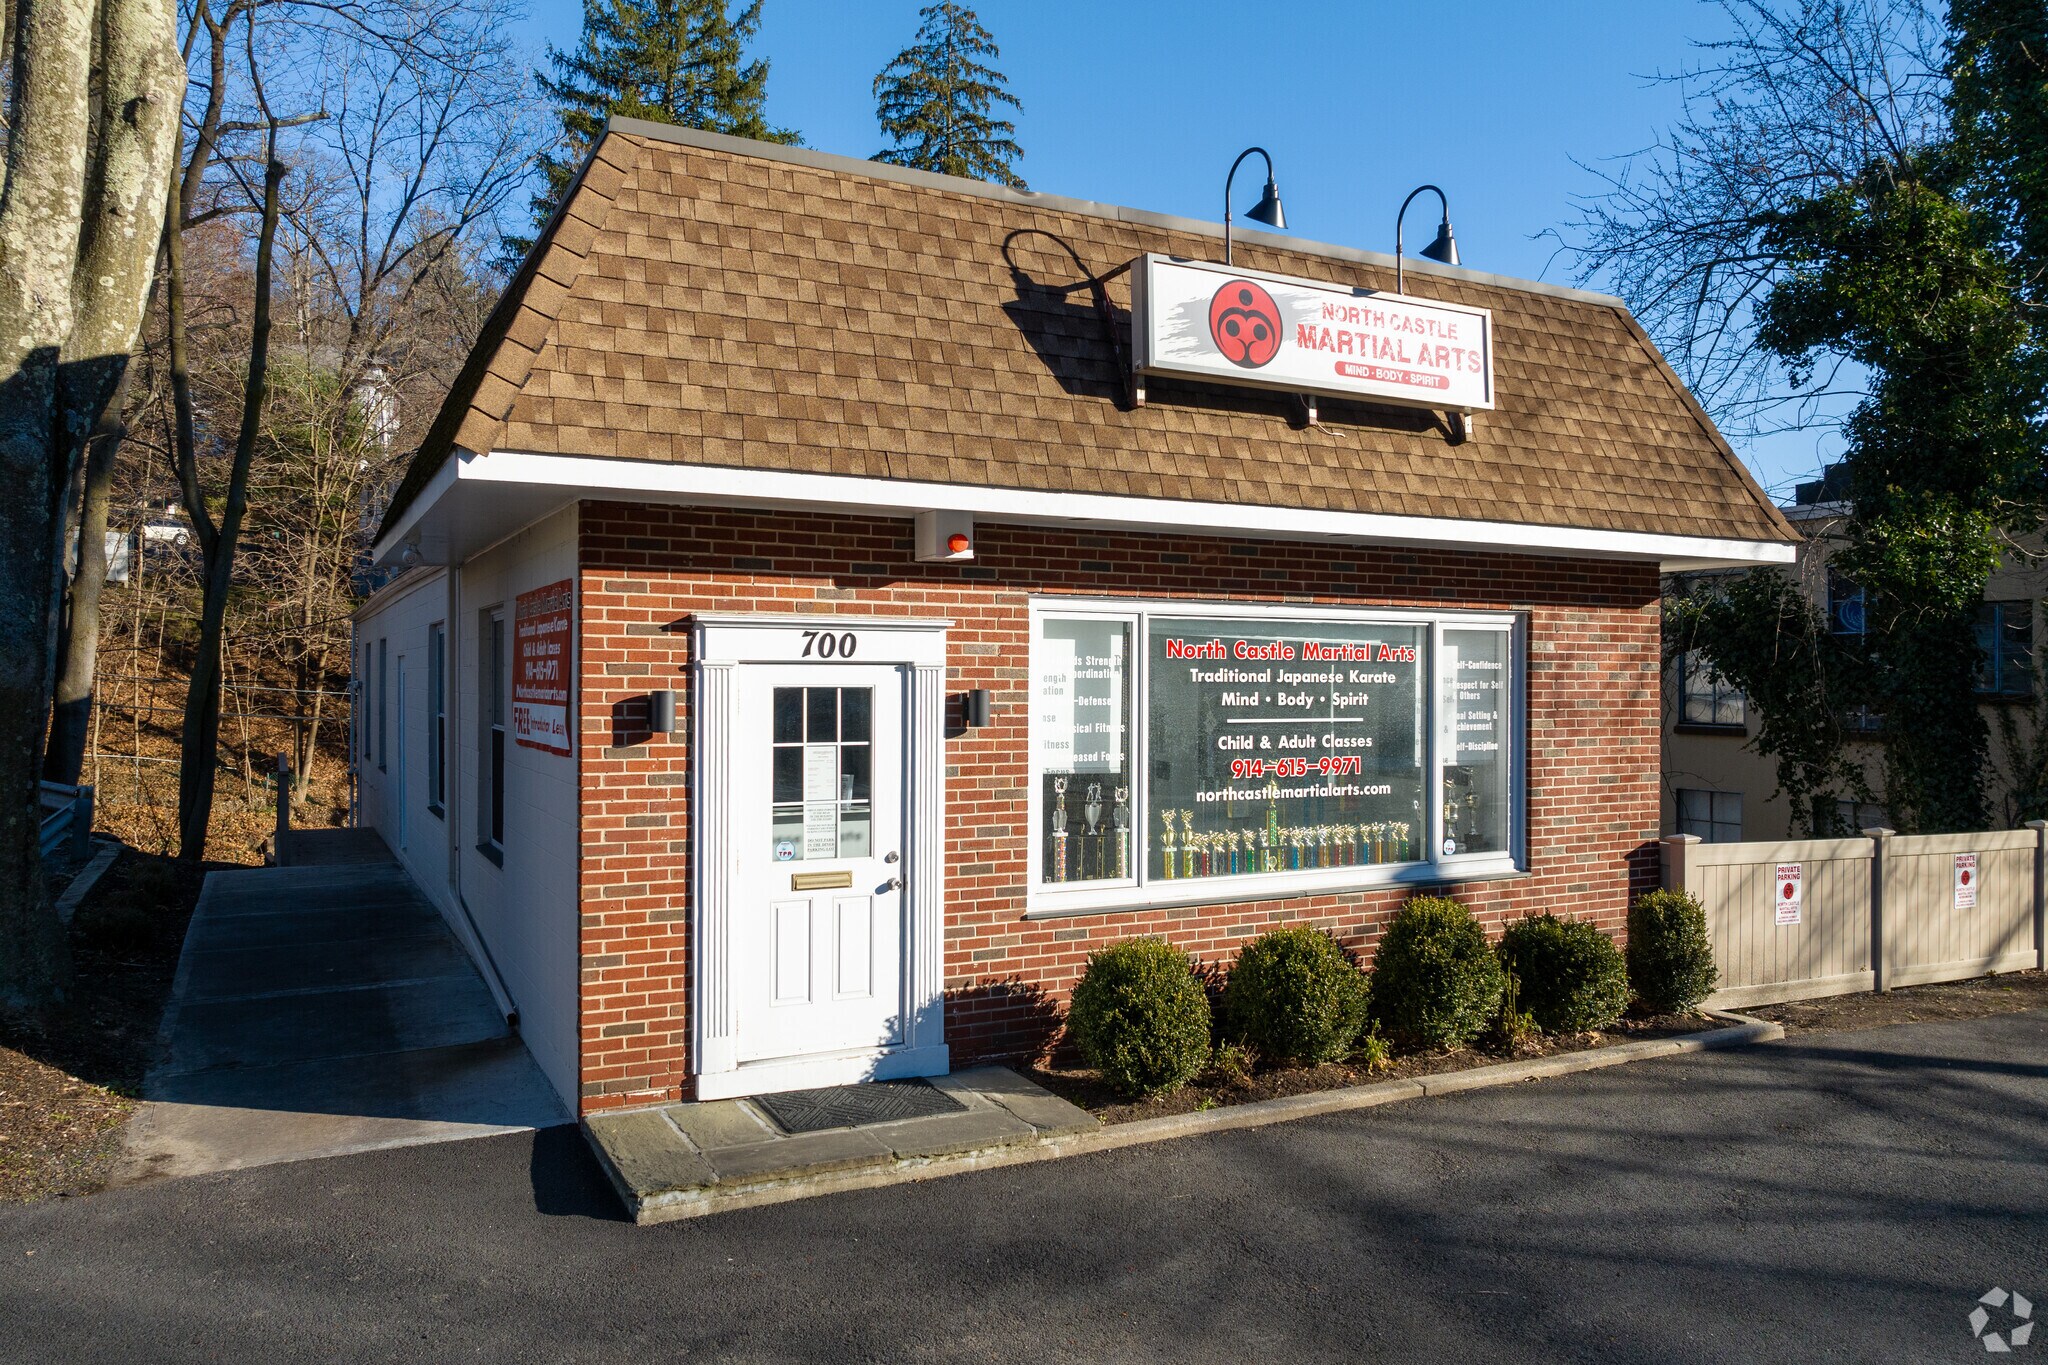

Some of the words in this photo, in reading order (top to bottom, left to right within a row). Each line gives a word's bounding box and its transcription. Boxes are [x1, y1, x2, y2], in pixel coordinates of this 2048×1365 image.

[1322, 302, 1385, 328] NORTH
[1389, 313, 1458, 340] CASTLE
[1296, 323, 1411, 363] MARTIAL
[1417, 342, 1481, 374] ARTS
[1344, 364, 1370, 377] MIND
[1375, 368, 1405, 382] BODY
[1410, 372, 1441, 387] SPIRIT
[801, 630, 857, 659] 700
[1166, 638, 1227, 660] North
[1233, 640, 1295, 661] Castle
[1302, 641, 1371, 661] Martial
[1377, 643, 1416, 662] Arts
[1073, 668, 1121, 679] oordination
[1190, 668, 1271, 684] Traditional
[1276, 669, 1344, 686] Japanese
[1349, 670, 1396, 684] Karate
[1479, 680, 1489, 690] for
[1490, 680, 1504, 690] Self
[1221, 692, 1259, 706] Mind
[1277, 692, 1314, 709] Body
[1332, 692, 1369, 709] Spirit
[1459, 690, 1481, 700] Others
[513, 706, 531, 736] FREE
[1468, 710, 1491, 721] Setting
[1492, 710, 1498, 720] &
[1095, 722, 1126, 733] Fitns
[1456, 721, 1493, 731] chievement
[1217, 735, 1254, 751] Child
[1259, 736, 1272, 749] &
[1278, 734, 1317, 749] Adult
[1321, 733, 1373, 748] Classes
[1456, 741, 1499, 752] elf-Discipline
[1100, 751, 1125, 761] Fos
[1230, 756, 1362, 779] 914-615-9971
[1196, 783, 1391, 802] northcastlemartialarts.com
[1777, 866, 1801, 874] PRIVATE
[1956, 861, 1975, 869] PARKING
[1777, 873, 1801, 881] PARKING
